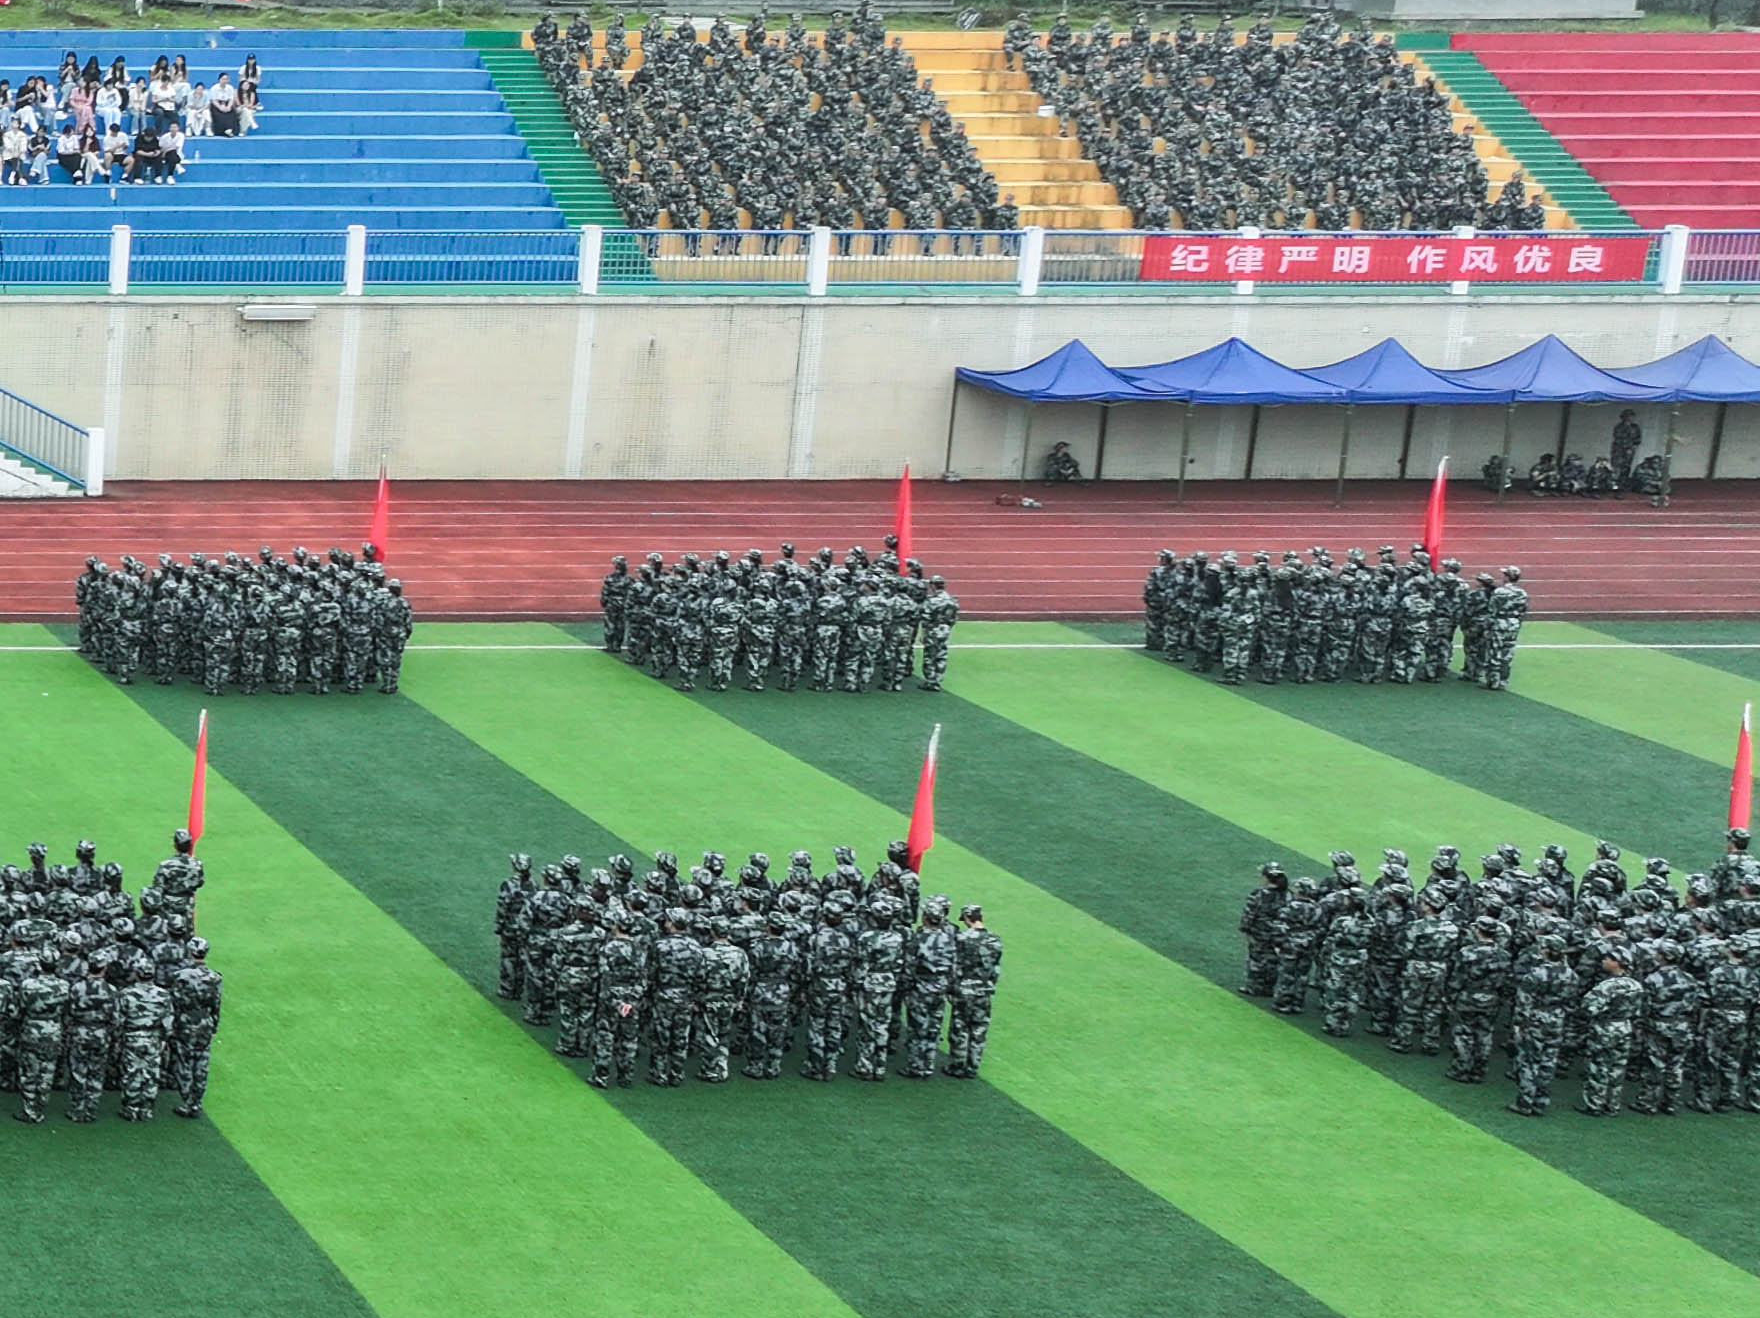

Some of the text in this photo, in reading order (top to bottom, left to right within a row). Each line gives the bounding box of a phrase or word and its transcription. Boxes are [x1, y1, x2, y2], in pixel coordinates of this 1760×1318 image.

[1169, 244, 1604, 274] 纪律严明 作风优良
